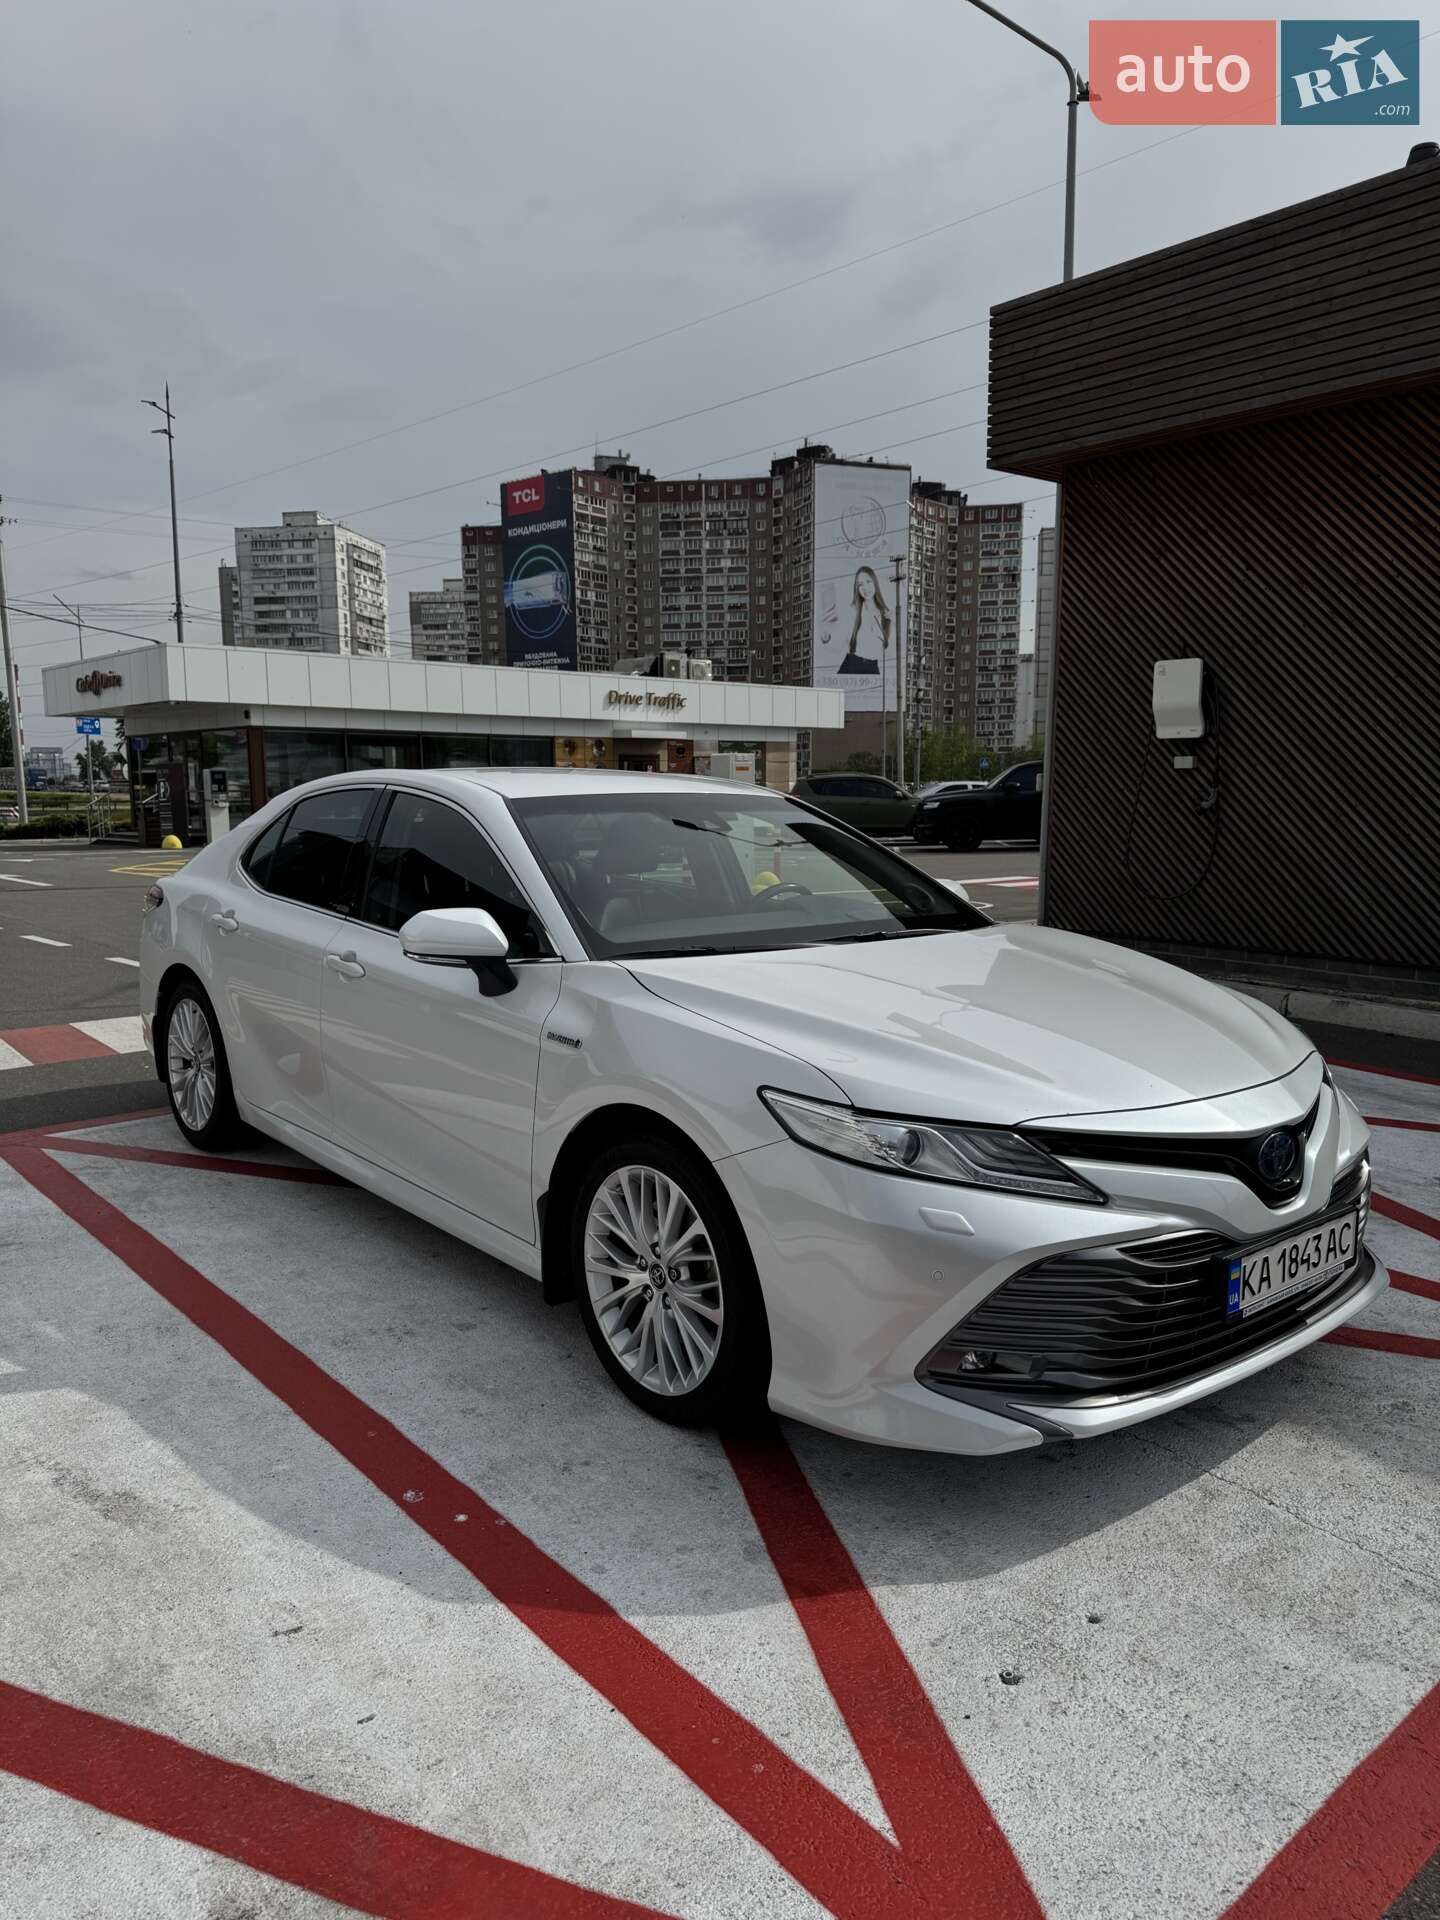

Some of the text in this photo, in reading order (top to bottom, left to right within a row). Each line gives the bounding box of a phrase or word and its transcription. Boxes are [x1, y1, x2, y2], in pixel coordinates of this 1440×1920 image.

[512, 488, 540, 505] TCL
[508, 519, 567, 537] КОНДИЦІОНЕРИ
[608, 690, 687, 710] Drive Traffic
[1242, 1256, 1272, 1300] KA
[1278, 1233, 1322, 1283] 1843
[1325, 1222, 1351, 1264] AC
[1229, 1294, 1239, 1305] UA
